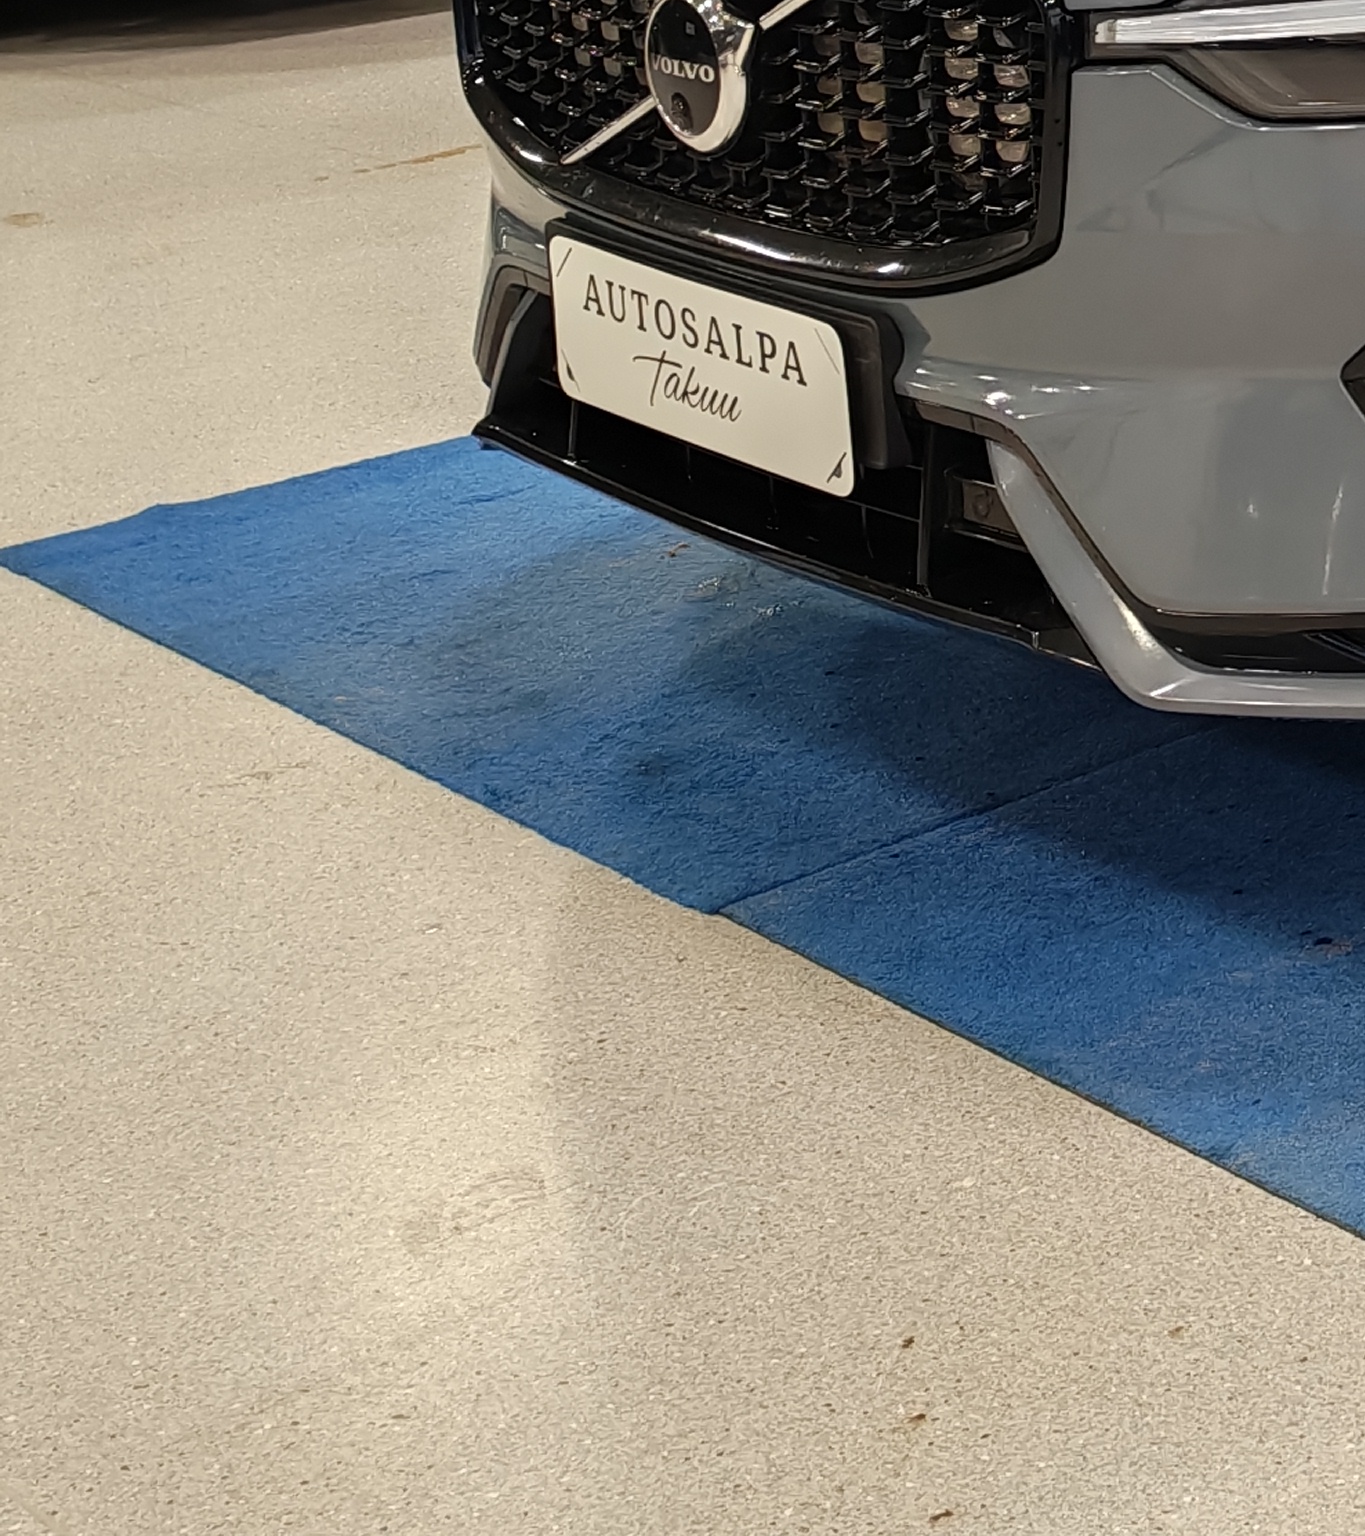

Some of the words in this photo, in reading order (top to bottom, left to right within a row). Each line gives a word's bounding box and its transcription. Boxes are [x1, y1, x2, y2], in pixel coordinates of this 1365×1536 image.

[650, 52, 715, 83] VOLVO
[582, 273, 808, 387] AUTOSALPA
[632, 350, 743, 422] Takuu
